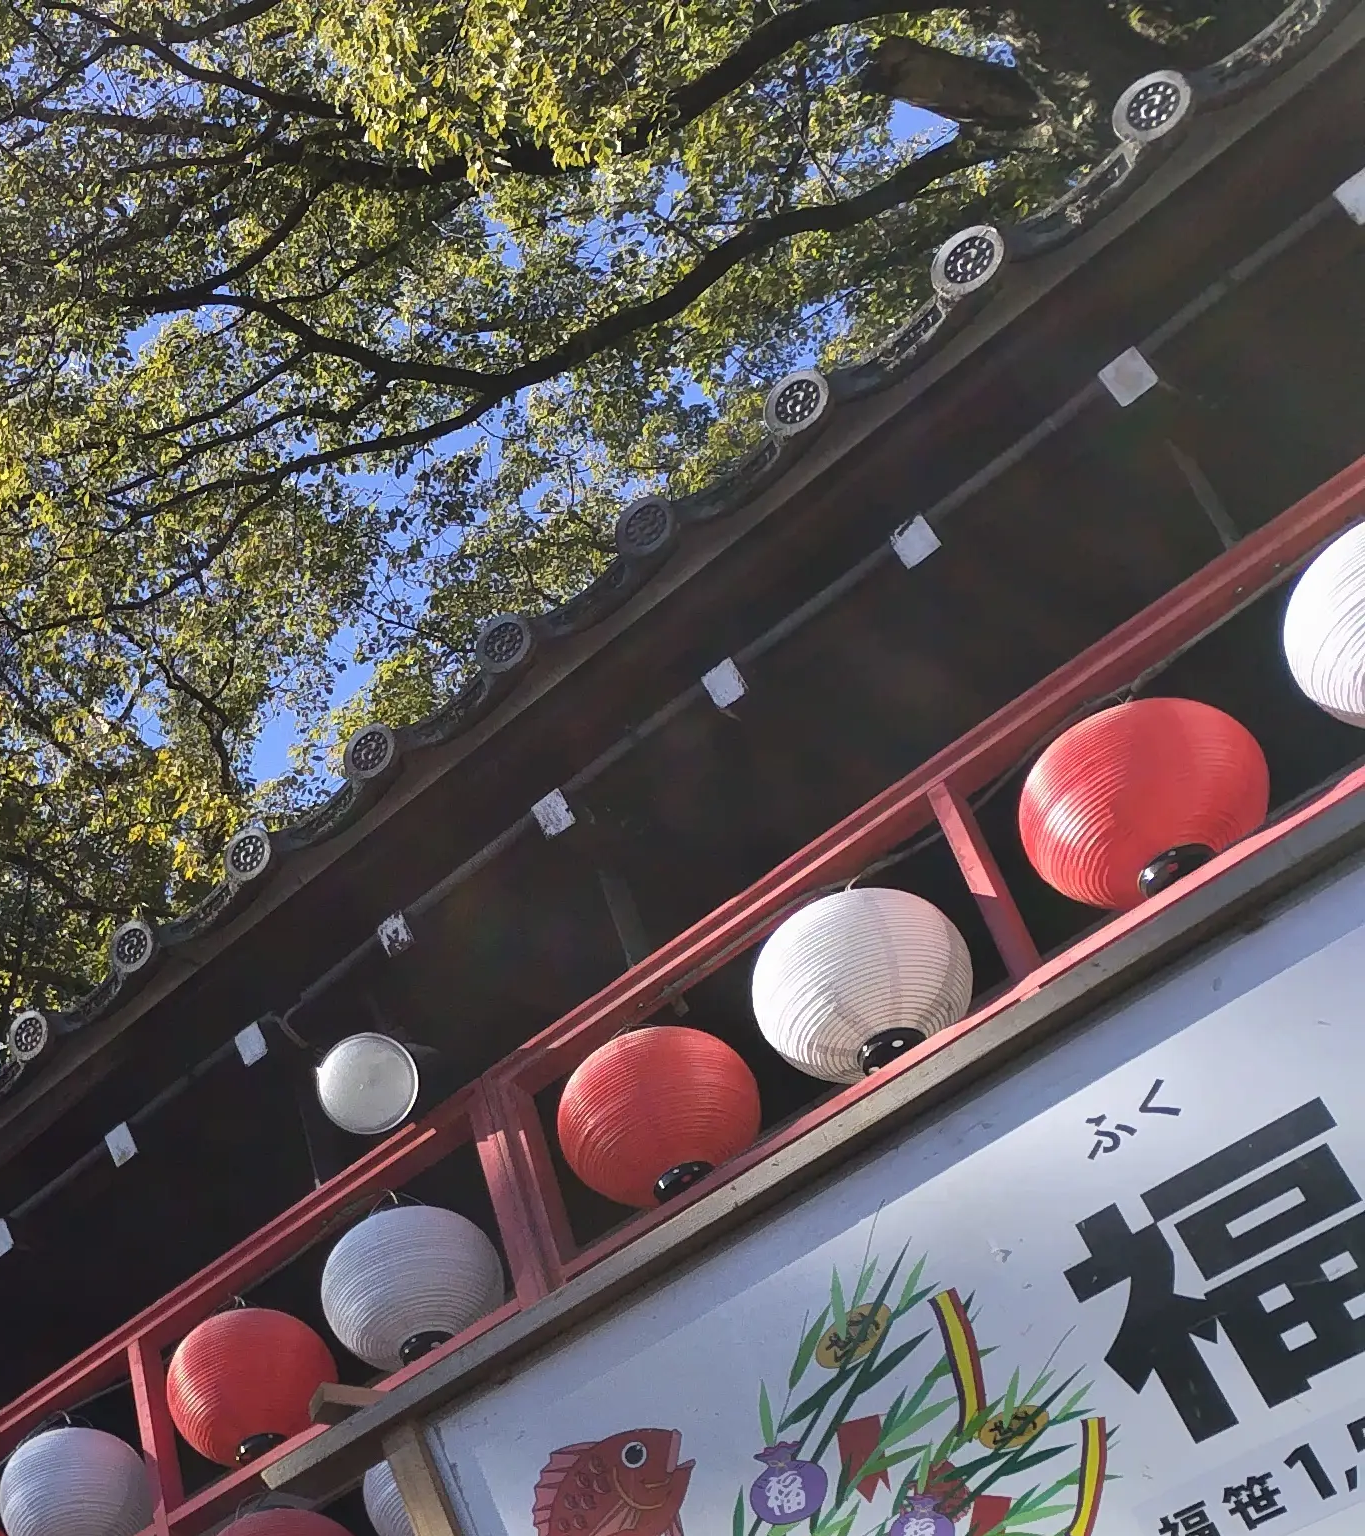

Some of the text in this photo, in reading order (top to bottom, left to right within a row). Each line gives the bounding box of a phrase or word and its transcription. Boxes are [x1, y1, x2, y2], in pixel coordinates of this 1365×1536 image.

[1085, 1078, 1182, 1161] ふく
[1063, 1096, 1365, 1445] 福
[764, 1470, 807, 1516] 福
